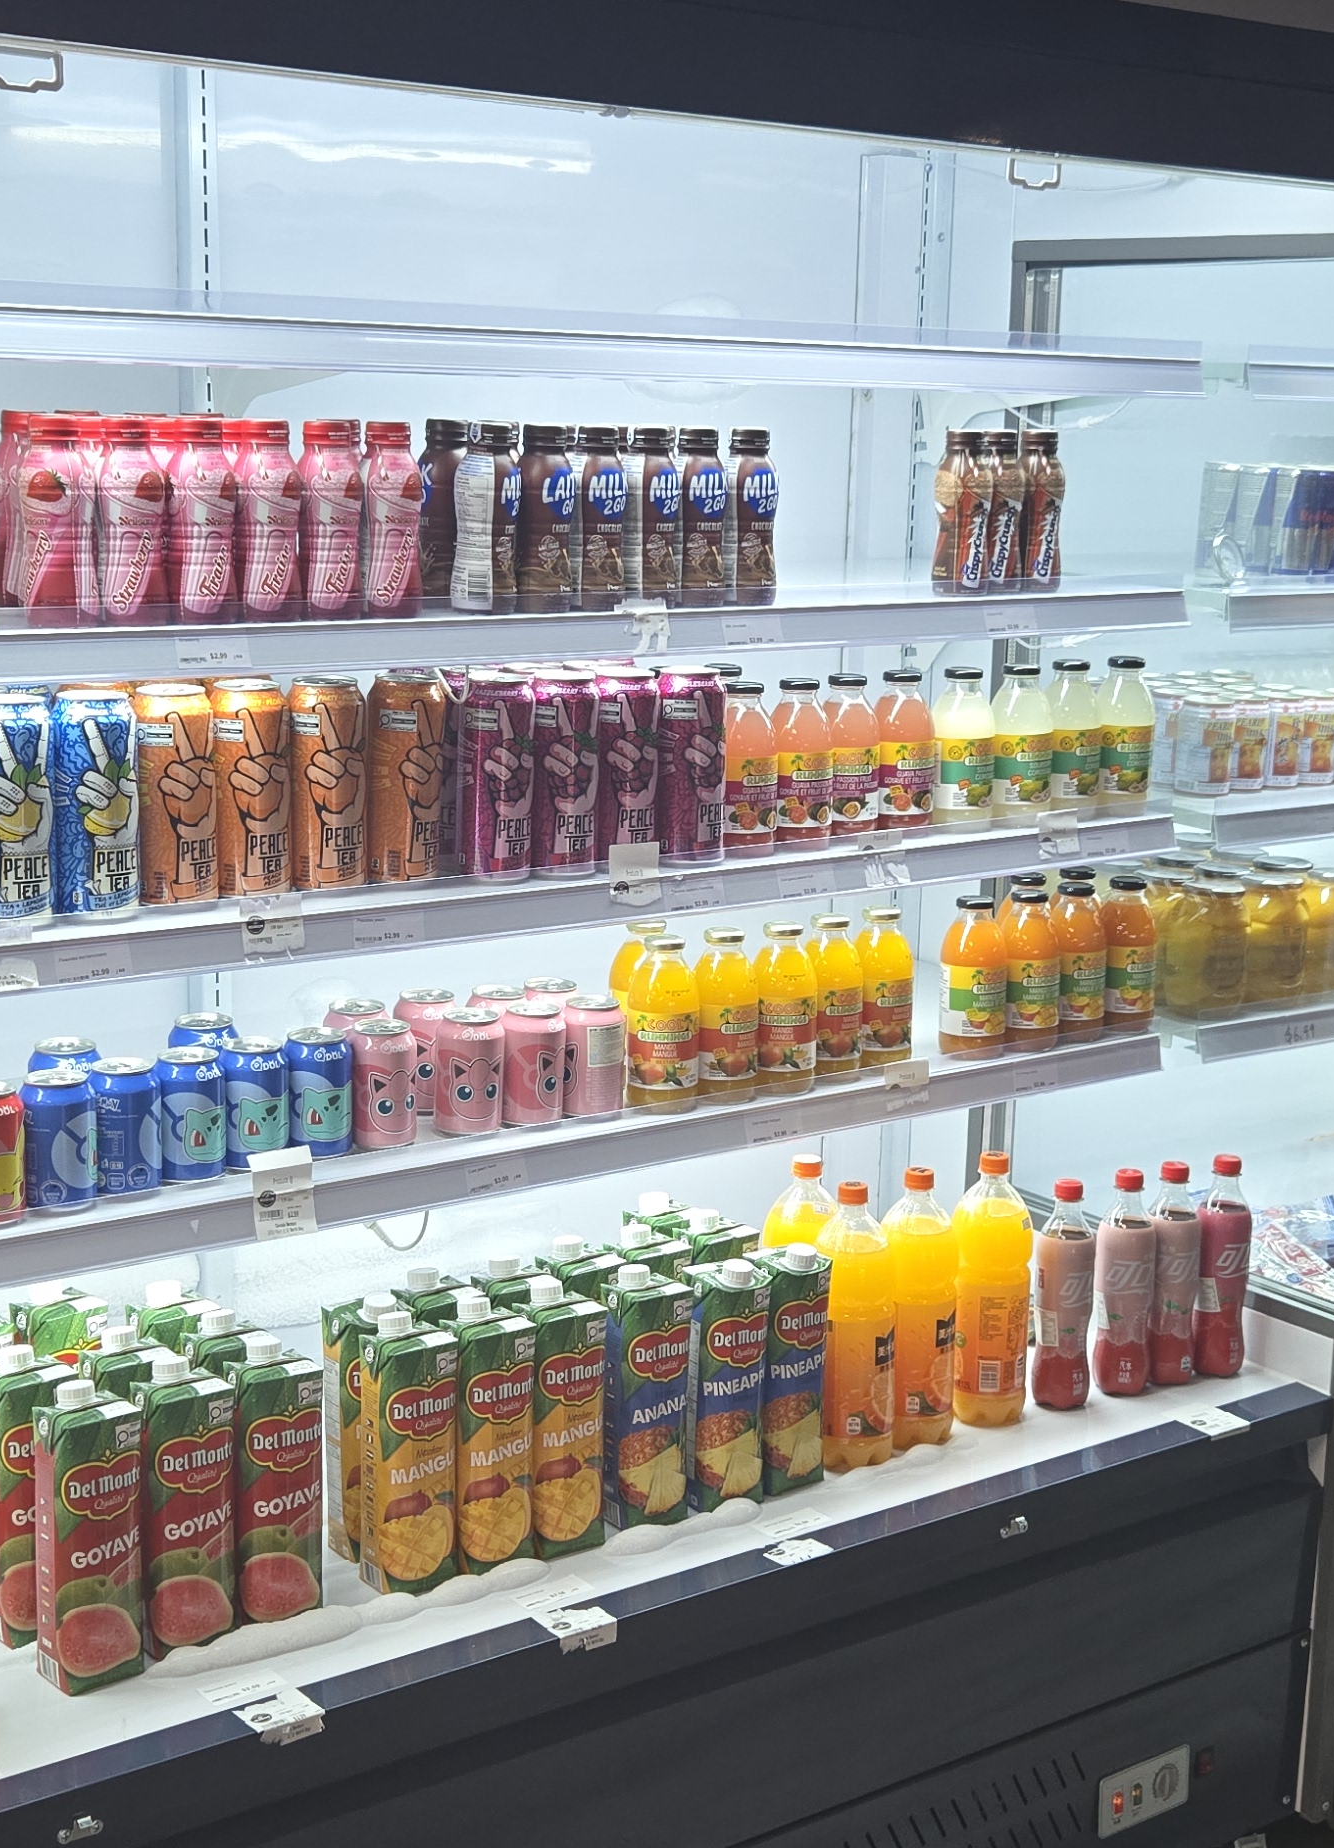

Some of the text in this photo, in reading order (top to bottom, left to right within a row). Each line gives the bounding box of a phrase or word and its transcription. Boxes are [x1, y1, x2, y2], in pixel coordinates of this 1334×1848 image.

[588, 472, 628, 502] MILK
[688, 472, 728, 501] MILK
[603, 497, 626, 515] 2GO
[703, 497, 726, 514] 2GO
[112, 531, 154, 613] Strawberry
[199, 545, 230, 599] Fraise
[261, 543, 291, 597] Fraise
[374, 527, 415, 606] Strawberry
[557, 812, 593, 835] PEACE
[249, 831, 288, 855] PEACE
[568, 837, 587, 851] TEA
[3, 855, 49, 881] PEACE
[97, 847, 136, 874] PEACE
[261, 857, 282, 874] TEA
[16, 882, 40, 899] TEA
[108, 875, 130, 892] TEA
[91, 967, 110, 977] $2.99
[765, 1003, 801, 1015] COOL
[648, 1018, 686, 1031] COOL
[639, 1031, 691, 1041] RUNNINGS
[652, 1050, 678, 1058] MANGUE
[653, 1043, 677, 1051] MANGO
[713, 1330, 737, 1349] Del
[733, 1344, 759, 1360] Quality
[703, 1369, 765, 1398] PINEAP
[632, 1393, 687, 1426] ANANA
[415, 1444, 445, 1460] Nectar
[68, 1464, 141, 1499] Del Monte
[94, 1493, 125, 1510] Qualité
[70, 1524, 141, 1570] GOYAVE
